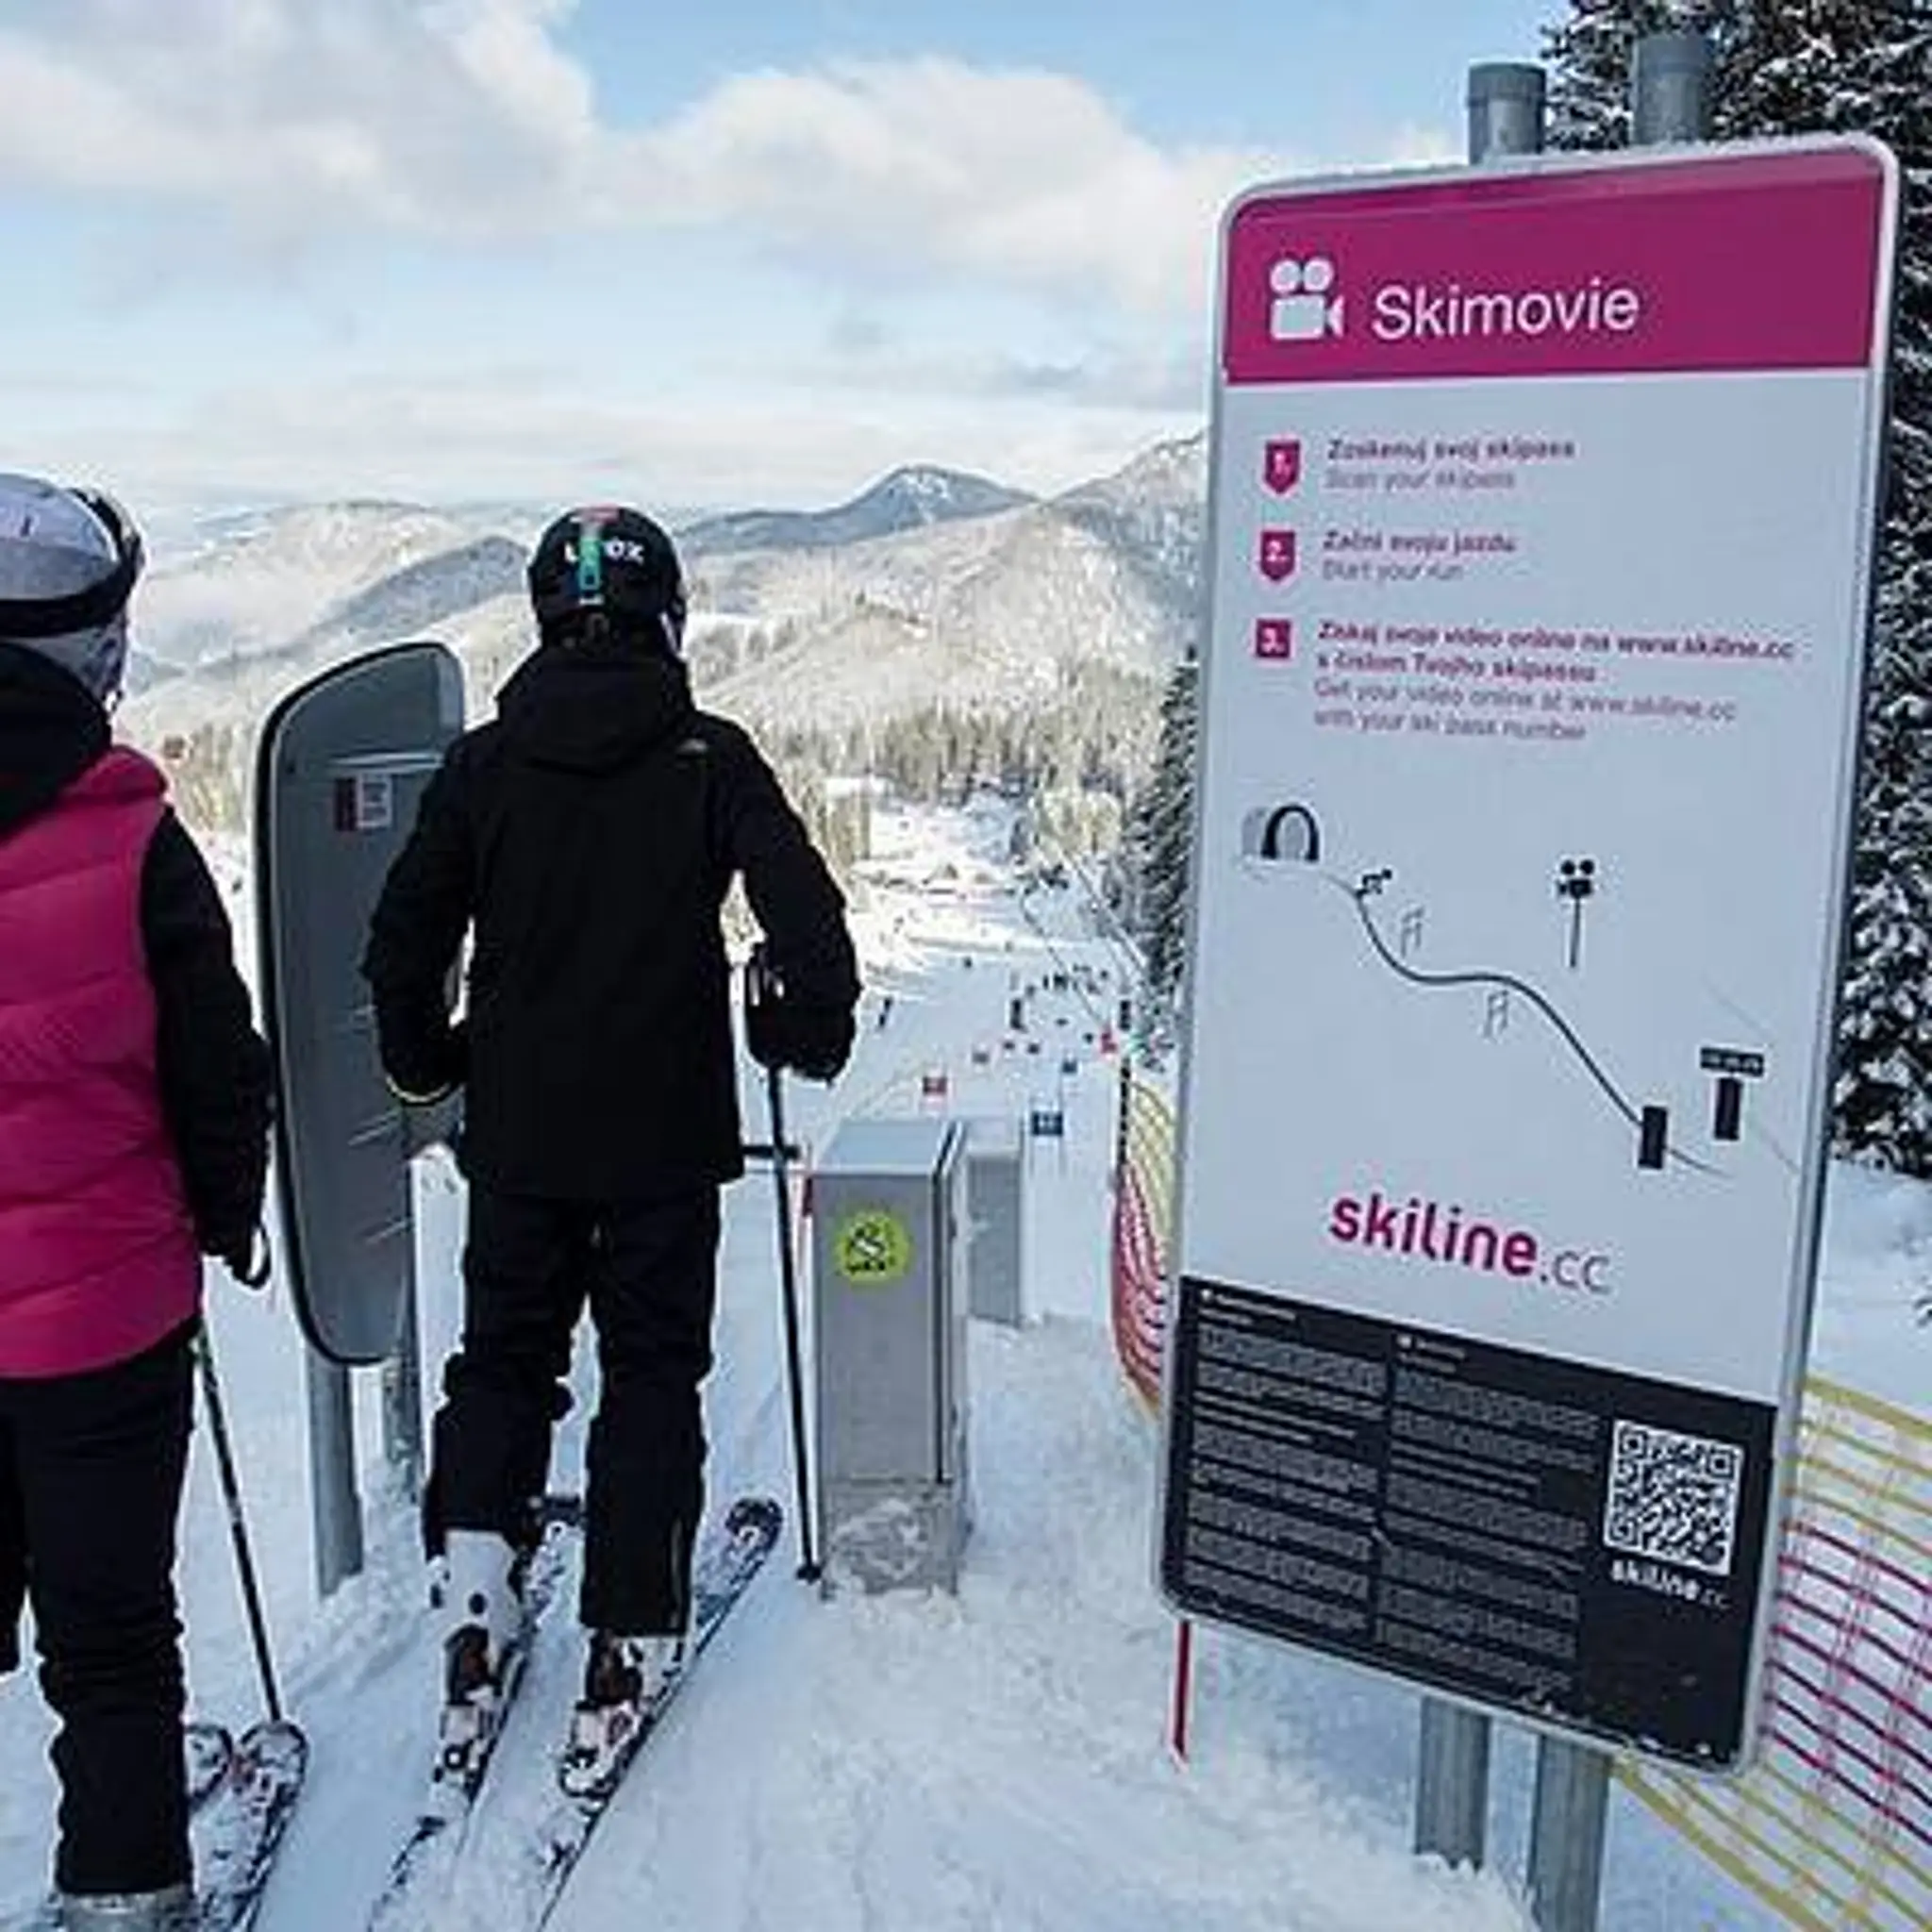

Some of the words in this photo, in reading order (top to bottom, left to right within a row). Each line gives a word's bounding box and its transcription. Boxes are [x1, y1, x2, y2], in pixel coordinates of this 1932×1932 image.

[1372, 275, 1640, 341] Skimovie
[1488, 438, 1574, 461] skipass
[1444, 626, 1503, 648] video
[1507, 625, 1574, 649] online
[1328, 1192, 1610, 1294] skiline.cc
